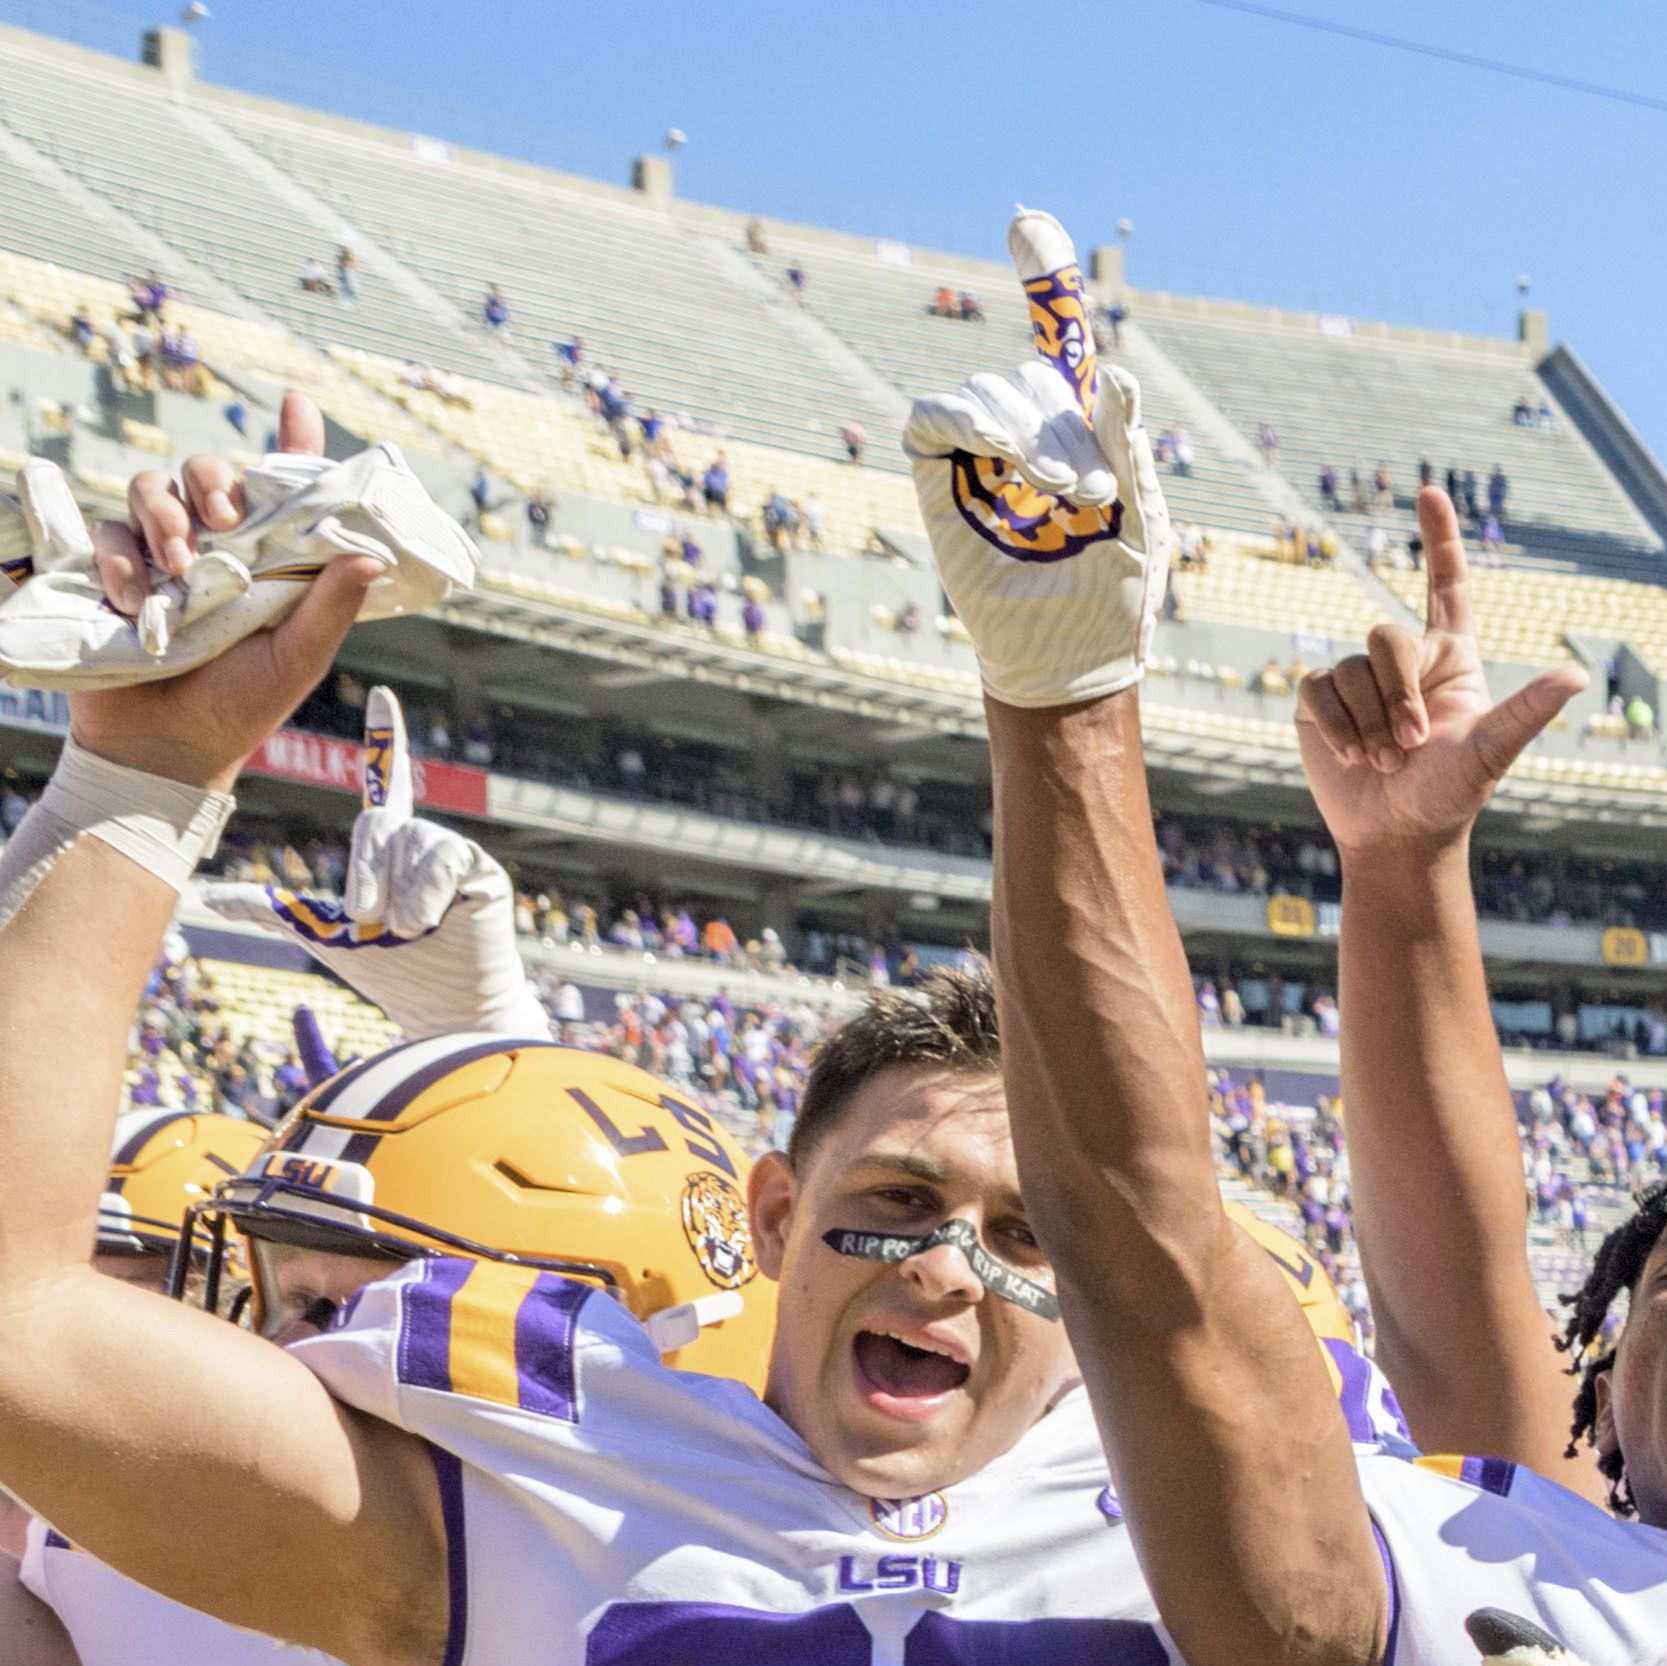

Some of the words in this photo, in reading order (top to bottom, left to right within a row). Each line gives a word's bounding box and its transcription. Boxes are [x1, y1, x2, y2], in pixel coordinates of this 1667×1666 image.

[563, 1087, 739, 1180] LS
[262, 1154, 333, 1189] LSU
[841, 1233, 879, 1255] RIP
[972, 1248, 1002, 1282] RIP
[1005, 1273, 1045, 1307] KAT
[839, 1554, 962, 1595] LSU
